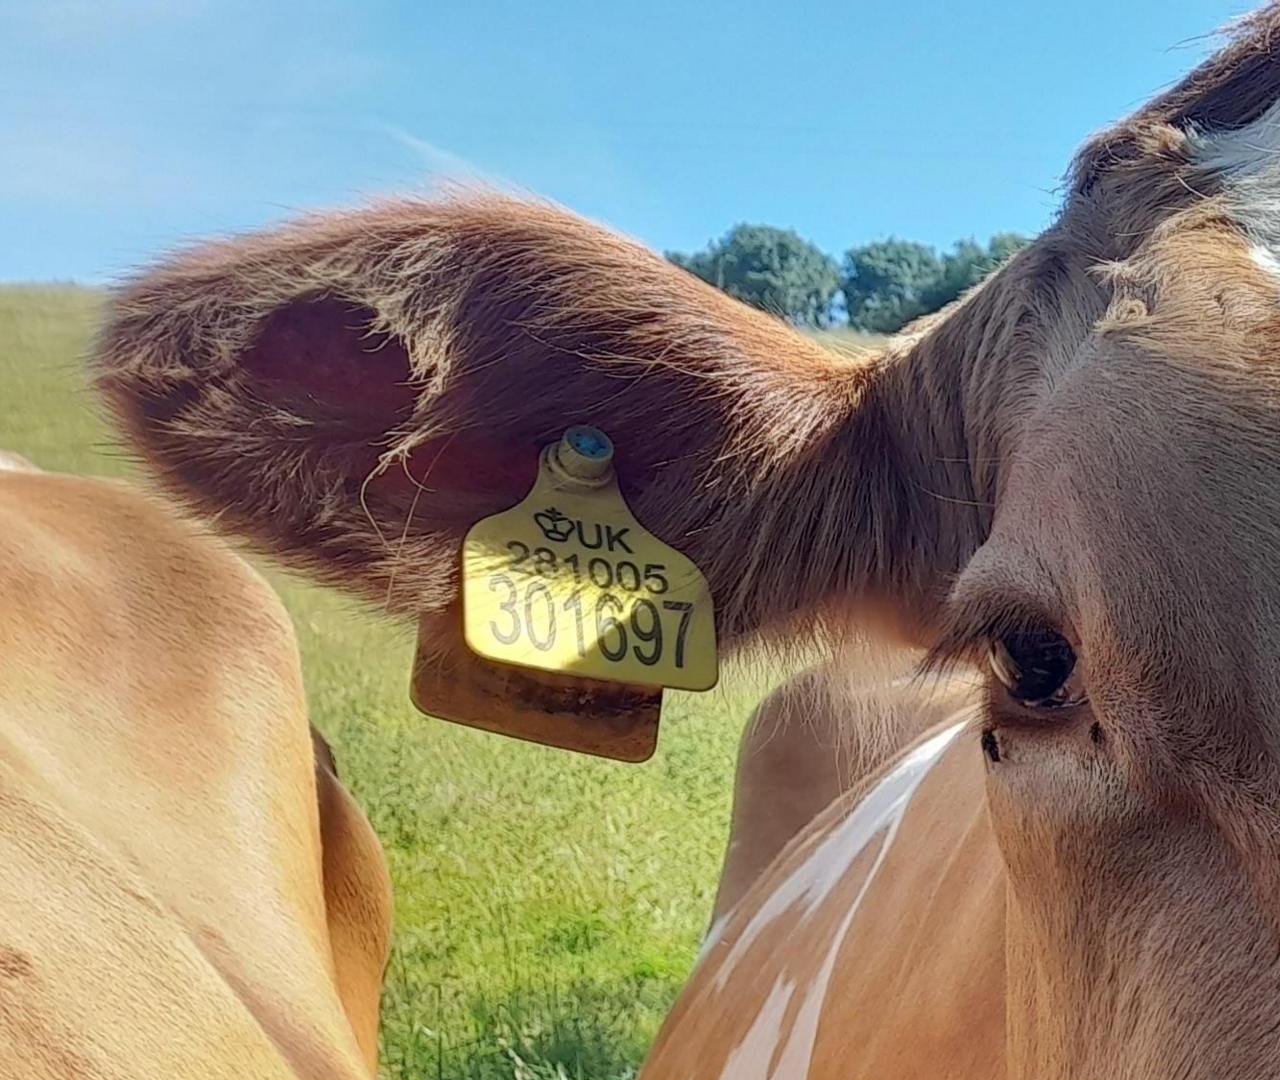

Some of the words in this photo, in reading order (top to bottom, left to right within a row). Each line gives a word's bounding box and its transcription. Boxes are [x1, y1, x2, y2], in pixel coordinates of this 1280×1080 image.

[577, 522, 633, 554] UK
[506, 540, 669, 594] 281005
[488, 573, 694, 669] 301697
